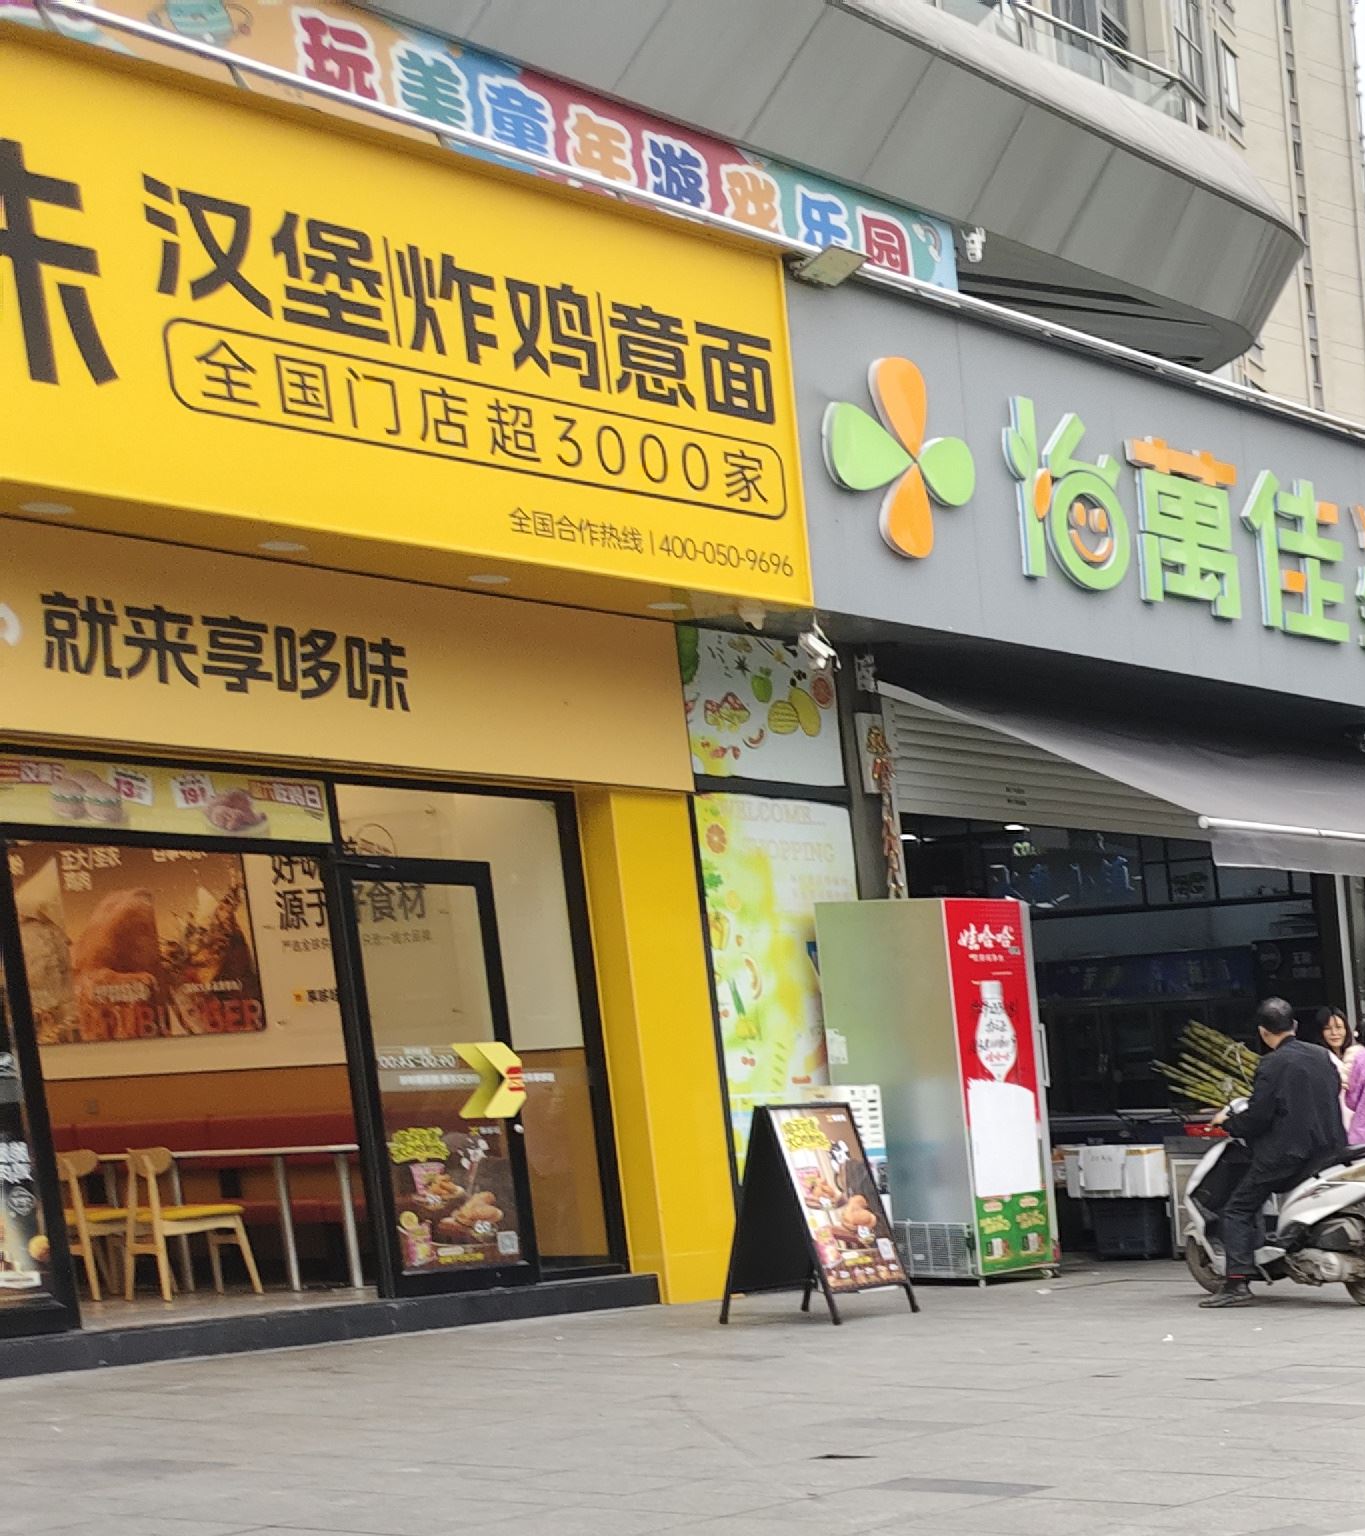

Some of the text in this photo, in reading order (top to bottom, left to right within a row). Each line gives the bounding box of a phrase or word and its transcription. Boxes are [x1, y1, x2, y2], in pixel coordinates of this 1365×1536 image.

[295, 12, 911, 277] 玩美童年游戏乐园
[197, 340, 769, 505] 全国门店超3000家
[508, 507, 794, 577] 全国合作热线 400-050-9696
[40, 591, 411, 712] 就来享哆味
[957, 922, 1016, 951] 娃哈哈
